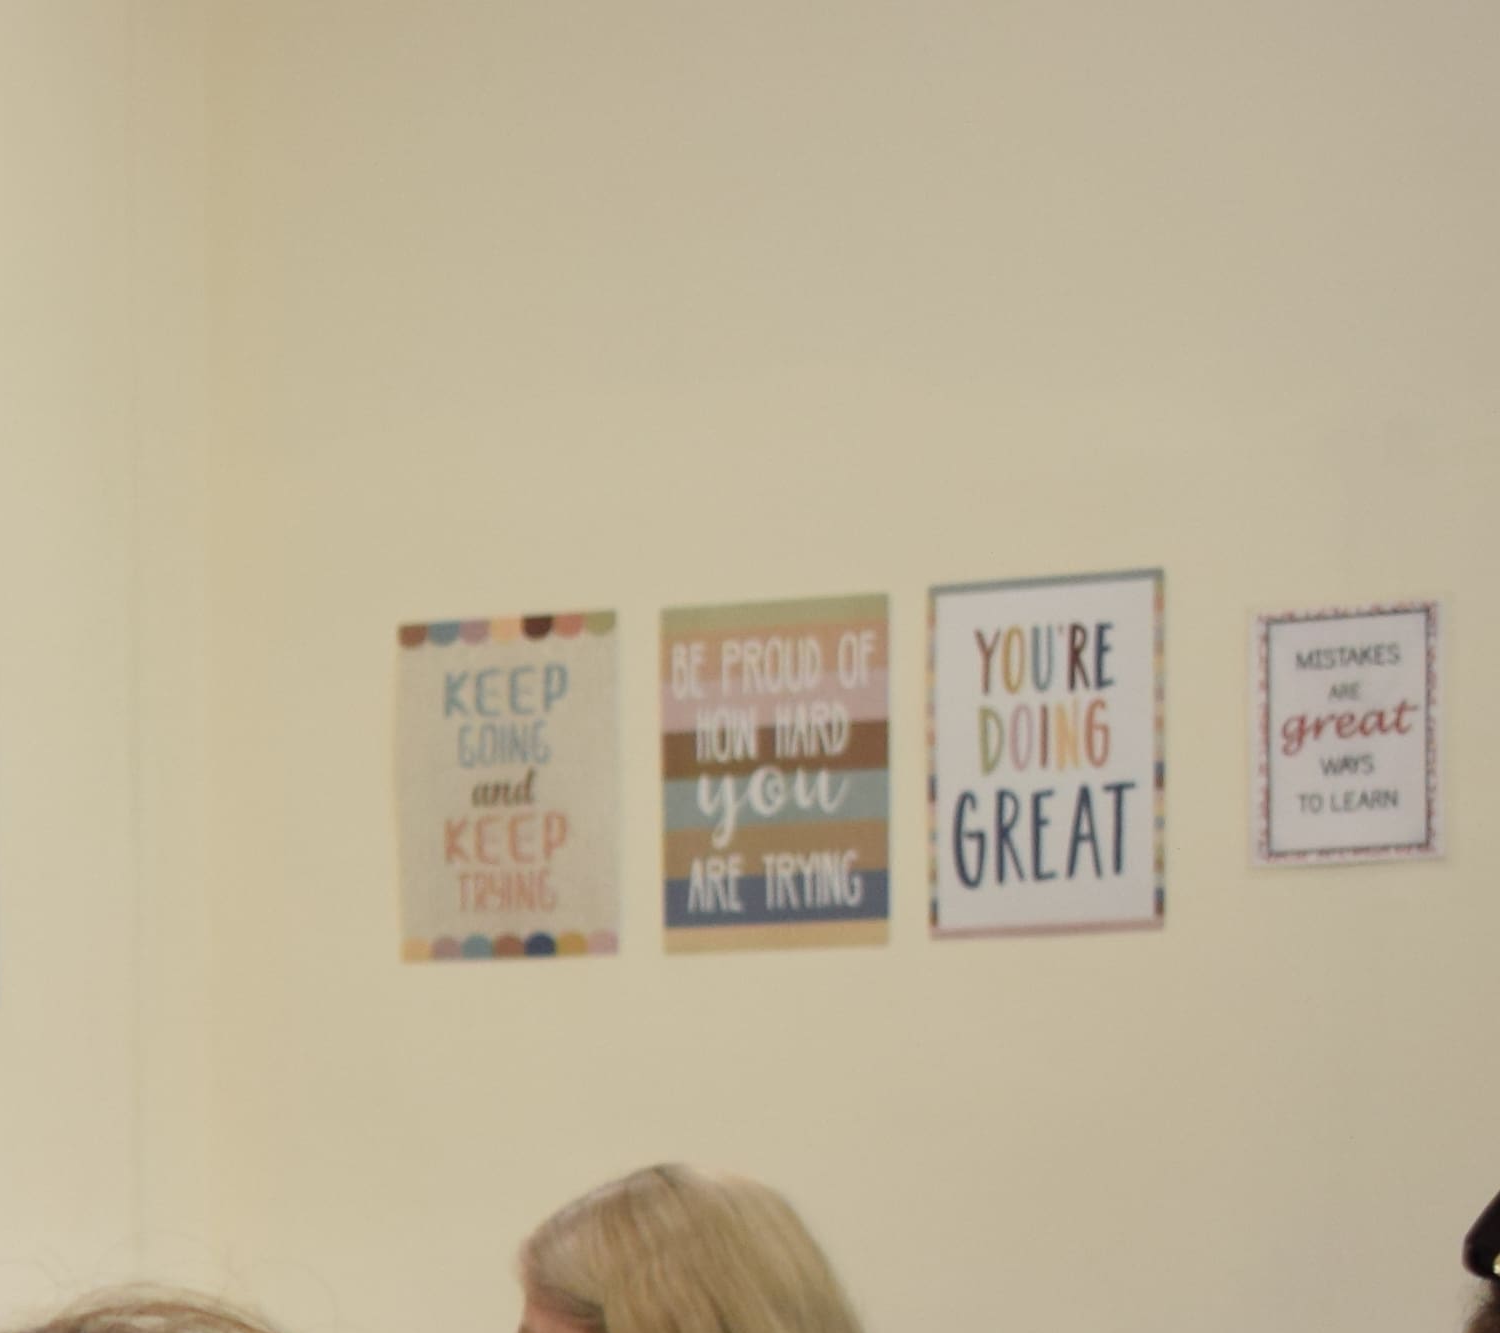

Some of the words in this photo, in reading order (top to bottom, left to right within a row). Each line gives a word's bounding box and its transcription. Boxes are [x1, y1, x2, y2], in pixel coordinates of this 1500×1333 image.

[671, 641, 706, 700] BE
[720, 636, 822, 697] PROUD
[838, 629, 877, 690] OF
[974, 621, 1115, 695] YOU'RE
[1295, 644, 1401, 671] MISTAKES
[443, 662, 570, 718] KEEP
[1328, 681, 1361, 700] ARE
[457, 719, 553, 769] GOING
[696, 706, 757, 762] HOW
[775, 702, 850, 758] HARD
[978, 697, 1111, 776] DOING
[1281, 699, 1419, 757] great
[471, 768, 537, 807] and
[1320, 754, 1375, 776] WAYS
[697, 765, 850, 850] you
[1297, 793, 1323, 814] TO
[1330, 789, 1398, 813] LEARN
[443, 810, 570, 865] KEEP
[953, 782, 1137, 889] GREAT
[458, 867, 557, 914] TRYING
[688, 856, 743, 913] ARE
[762, 850, 863, 910] TRYING
